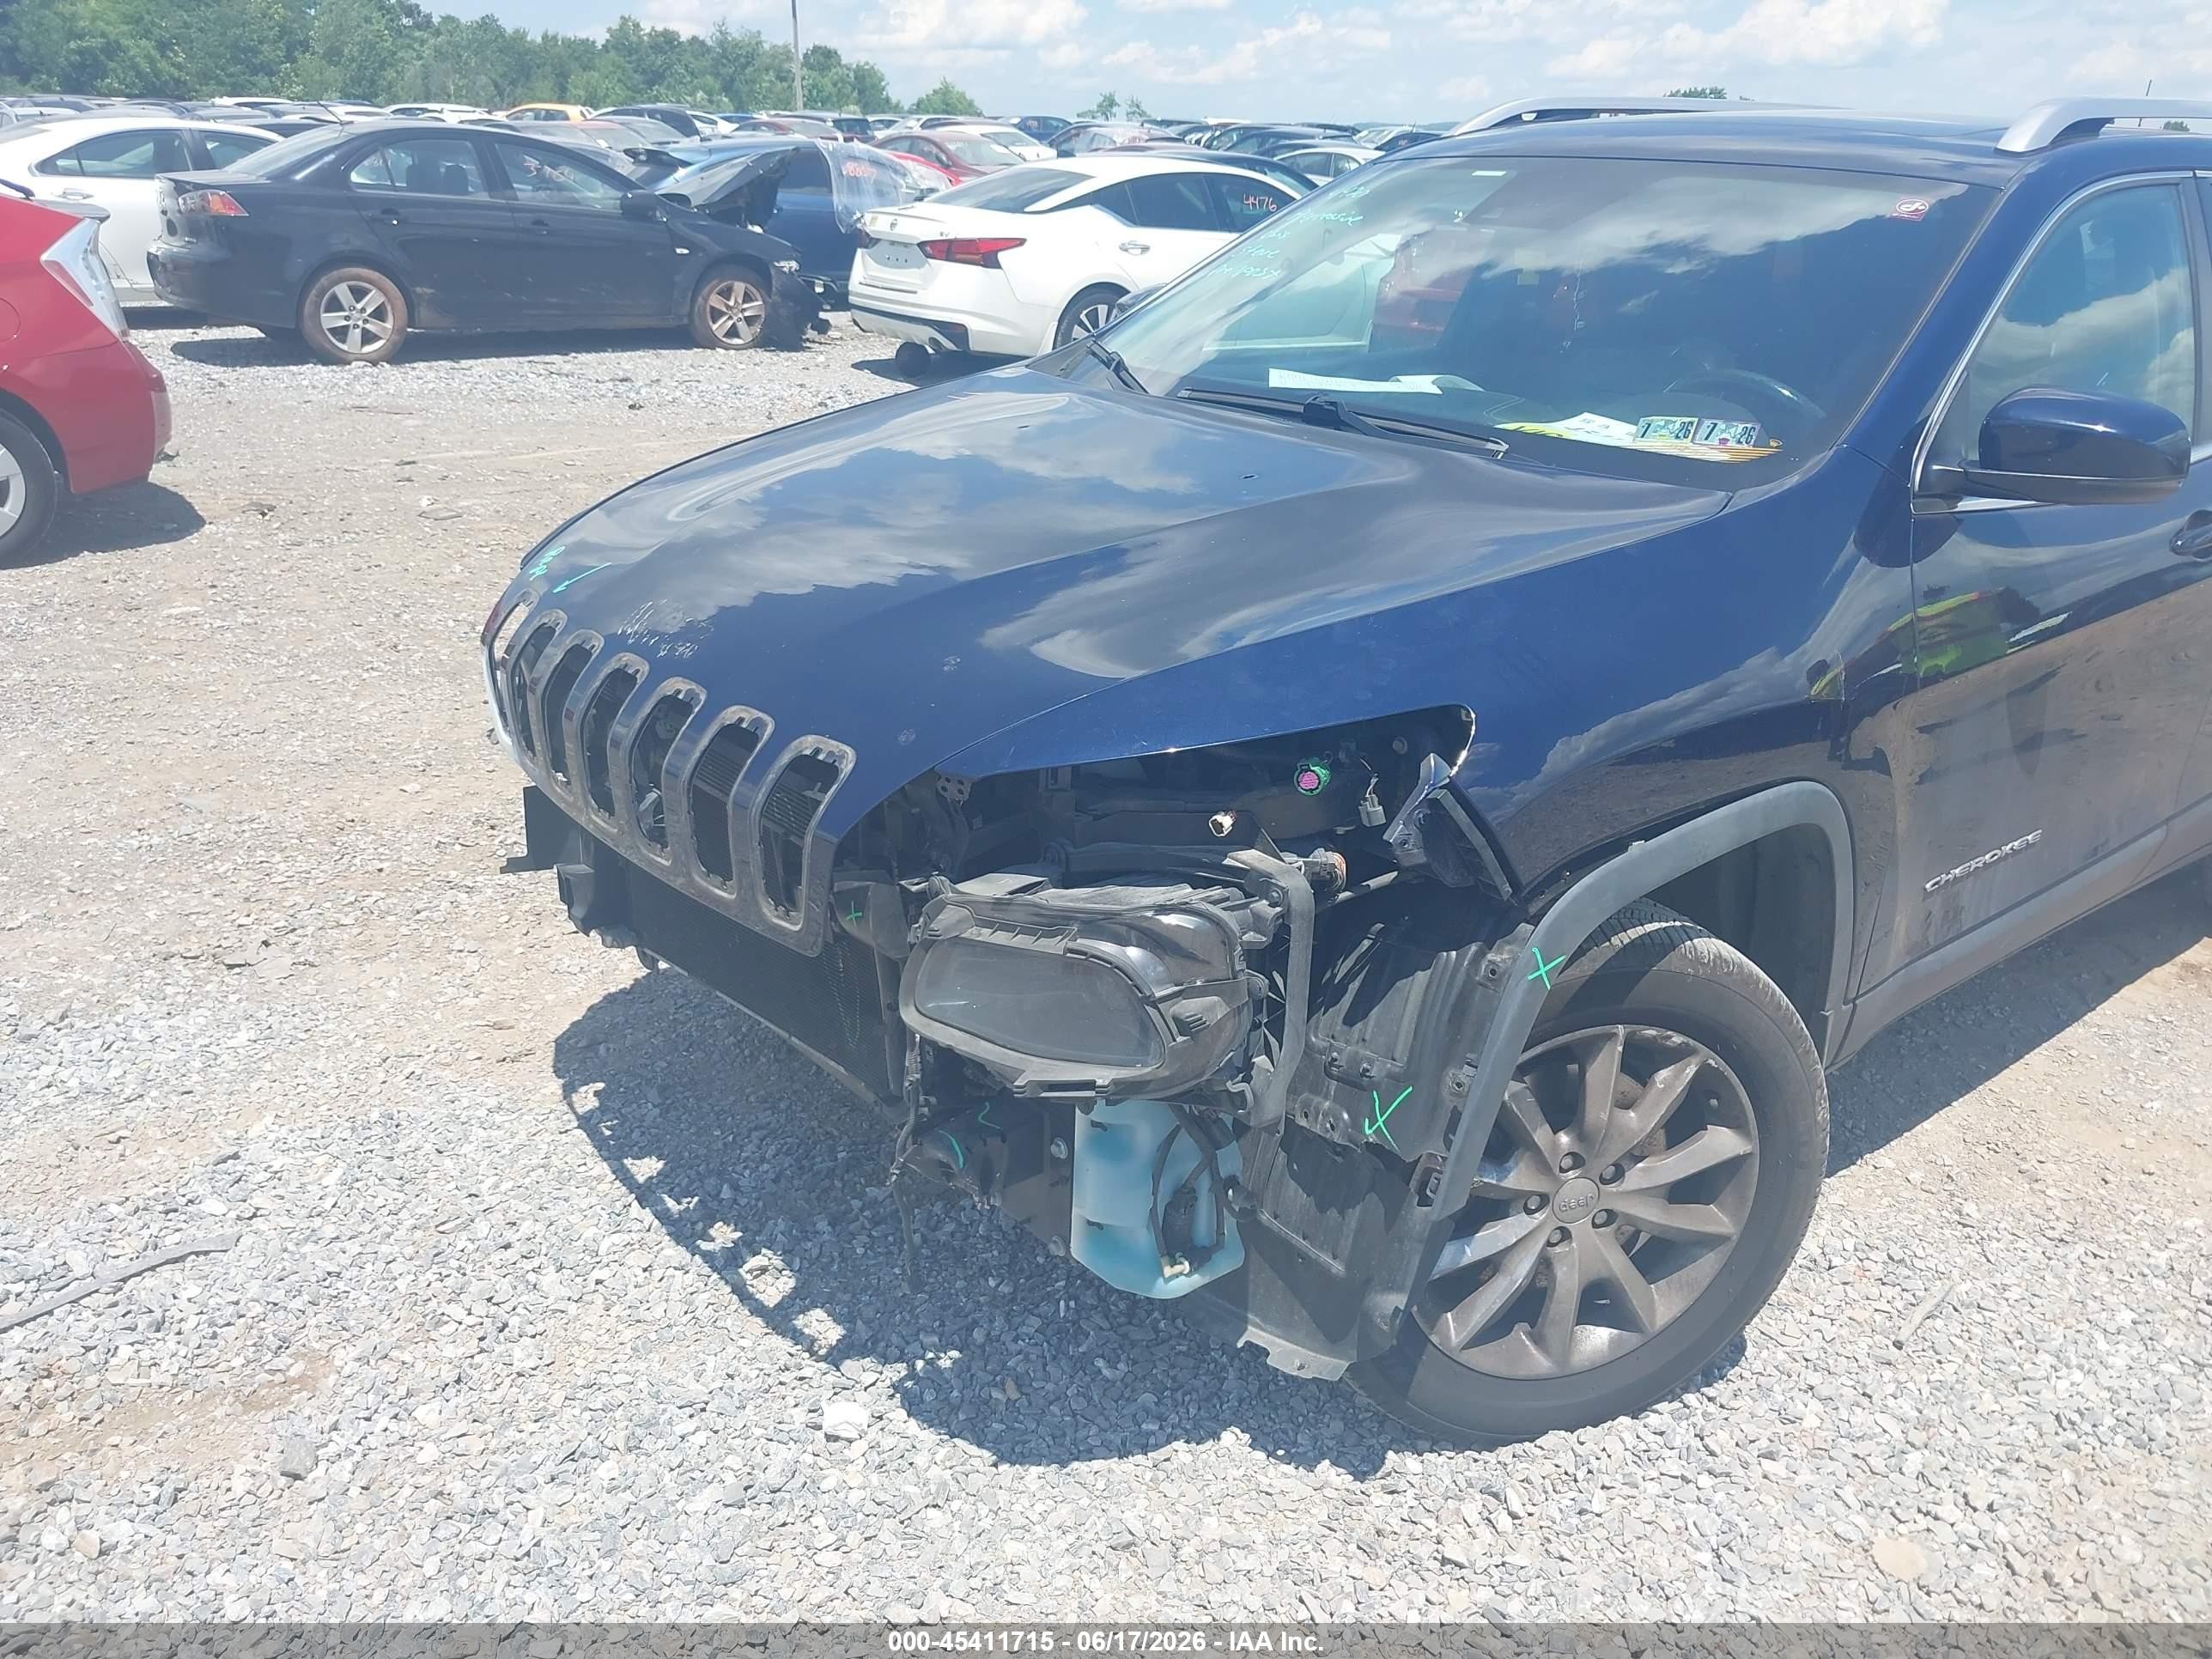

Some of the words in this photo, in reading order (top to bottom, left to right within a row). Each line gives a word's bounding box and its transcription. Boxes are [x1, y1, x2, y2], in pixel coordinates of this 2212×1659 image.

[1243, 192, 1278, 212] 4476
[1640, 422, 1652, 439] 7
[1675, 421, 1693, 440] 26
[1704, 422, 1718, 441] 7
[1737, 426, 1756, 445] 26
[1924, 829, 2043, 892] CHEROKEE
[1559, 1193, 1595, 1212] Jeep
